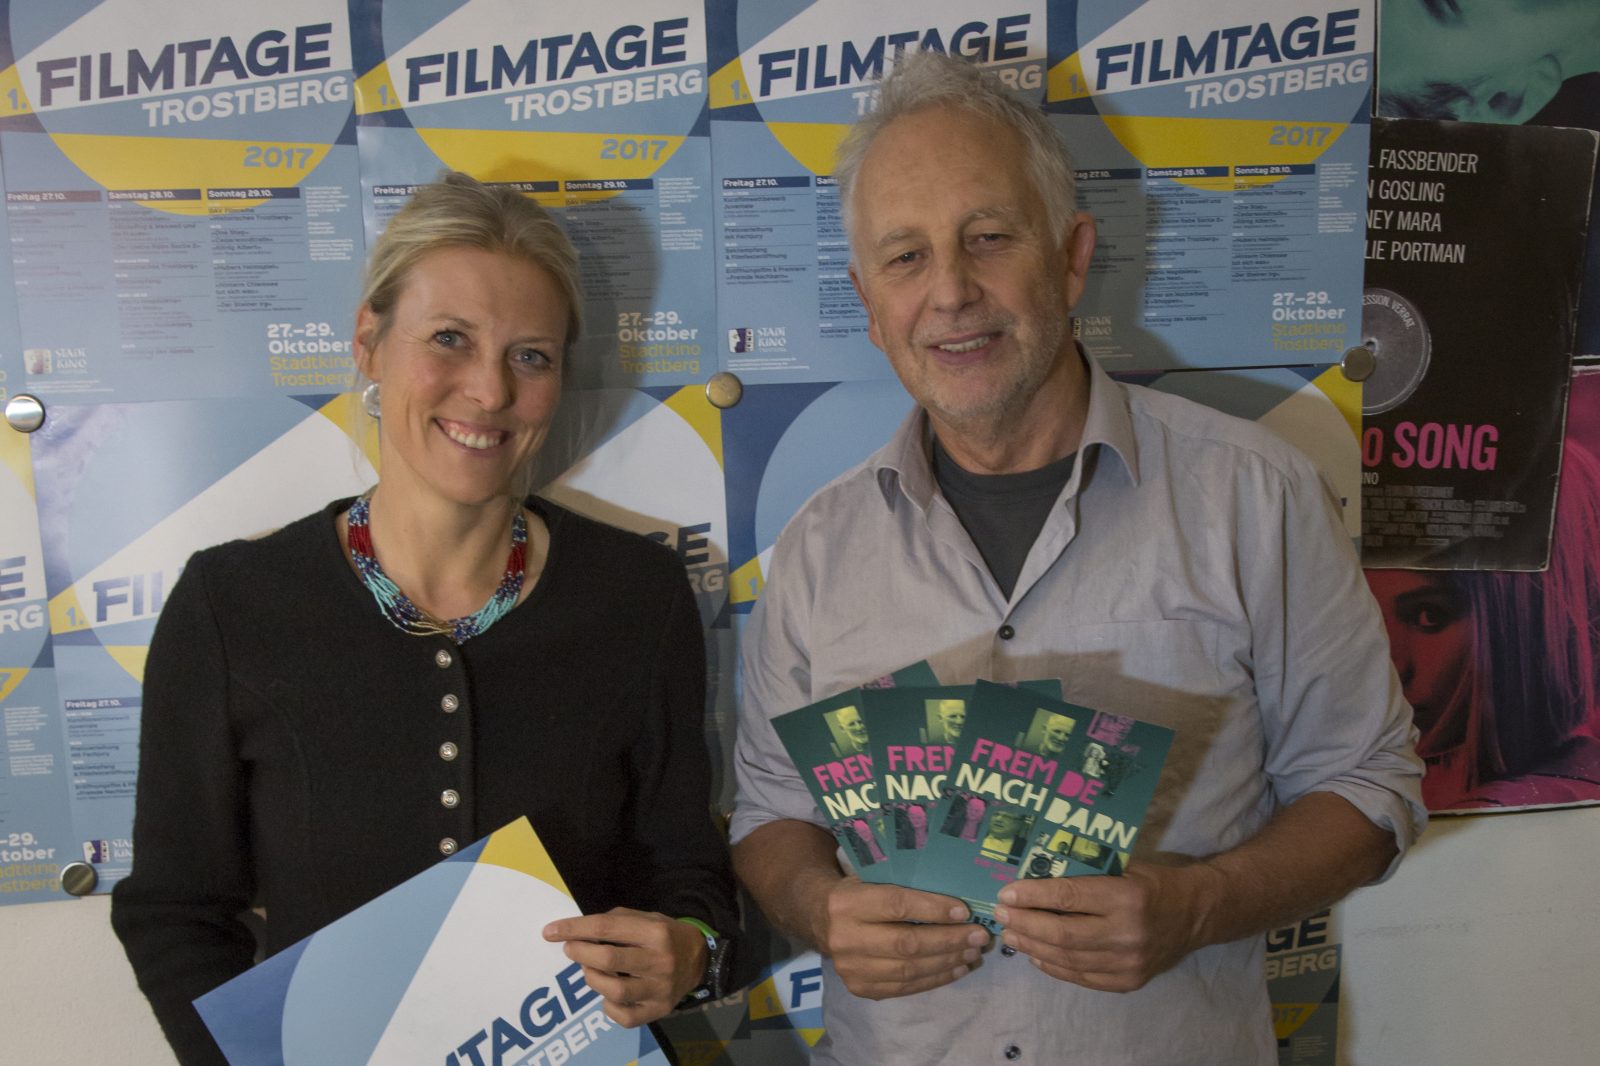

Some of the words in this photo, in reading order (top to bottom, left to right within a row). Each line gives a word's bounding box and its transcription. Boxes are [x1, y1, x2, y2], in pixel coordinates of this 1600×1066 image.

[1069, 74, 1084, 94] 1.
[1095, 8, 1360, 91] FILMTAGE
[8, 88, 27, 110] 1.
[37, 22, 333, 107] FILMTAGE
[378, 86, 396, 106] 1.
[406, 17, 689, 102] FILMTAGE
[730, 79, 747, 101] 1.
[1185, 59, 1368, 109] TROSTBERG
[142, 75, 349, 128] TROSTBERG
[504, 69, 703, 121] TROSTBERG
[1269, 126, 1332, 147] 2017
[243, 146, 314, 169] 2017
[600, 139, 669, 161] 2017
[1379, 149, 1478, 174] FASSBENDER
[1147, 169, 1183, 177] Samstag
[108, 192, 149, 200] Samstag
[150, 191, 175, 199] 28.10.
[208, 190, 247, 199] Sonntag
[248, 189, 273, 198] 29.10.
[374, 187, 406, 196] Freitag
[566, 182, 602, 190] Sonntag
[603, 181, 628, 189] 29.10.
[1378, 180, 1445, 203] GOSLING
[7, 193, 41, 202] Freitag
[42, 192, 66, 200] 27.10.
[1366, 210, 1394, 230] NEY
[1397, 211, 1442, 232] MARA
[1364, 240, 1386, 260] LIE
[1390, 240, 1466, 264] PORTMAN
[1272, 306, 1346, 322] Oktober
[619, 326, 699, 342] Oktober
[1272, 323, 1347, 337] Stadtkino
[268, 338, 353, 354] Oktober
[620, 344, 701, 358] Stadtkino
[758, 337, 787, 347] KINO
[1272, 337, 1345, 353] Trostberg
[622, 359, 700, 375] Trostberg
[271, 372, 355, 388] Trostberg
[1391, 421, 1499, 471] SONG
[66, 607, 84, 626] 1.
[66, 701, 97, 709] Freitag
[971, 737, 1058, 785] FREM
[1056, 770, 1104, 805] DE
[955, 763, 1048, 812] NACH
[1044, 797, 1138, 849] BARN
